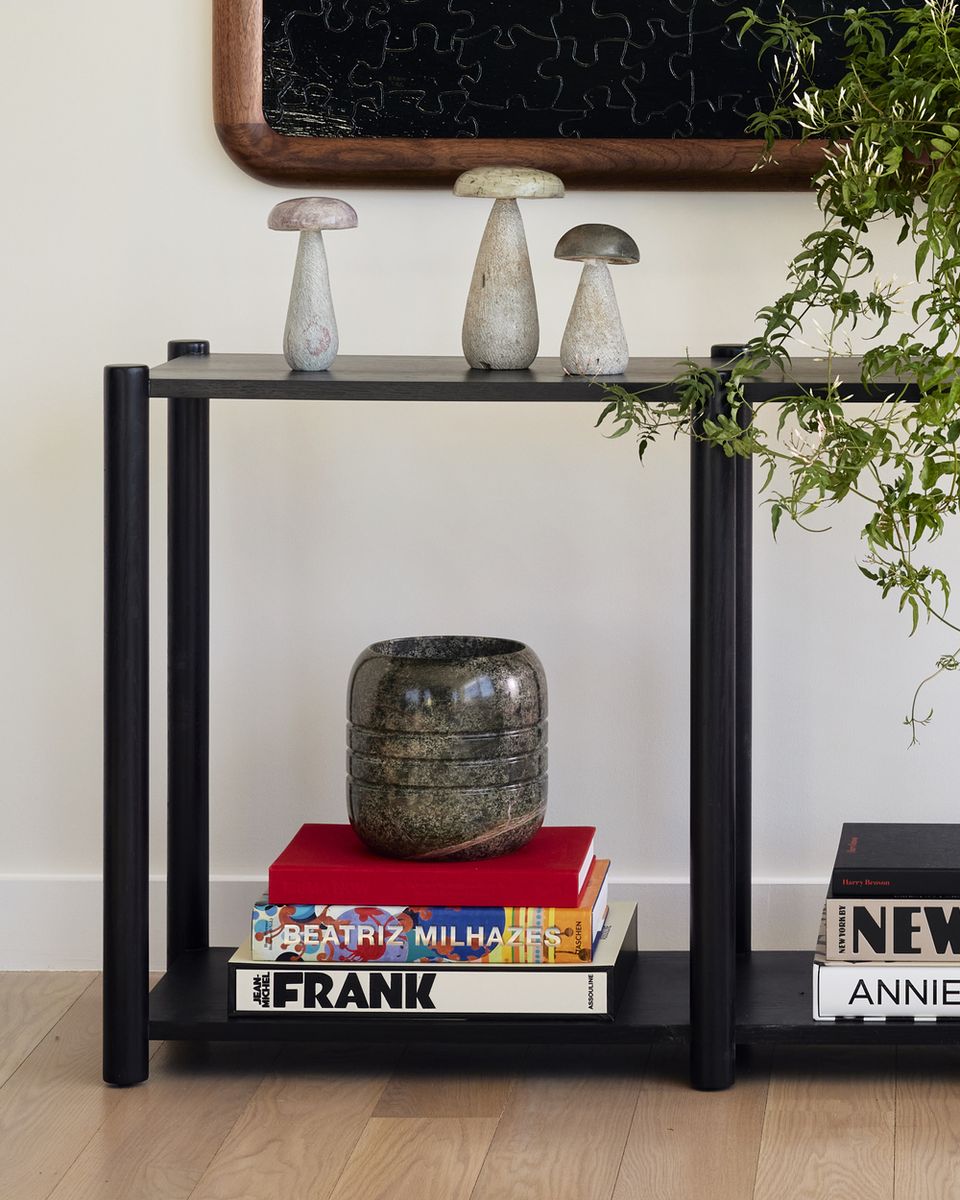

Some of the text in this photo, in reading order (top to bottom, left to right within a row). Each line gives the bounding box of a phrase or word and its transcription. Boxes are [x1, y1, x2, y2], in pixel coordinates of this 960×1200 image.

[842, 879, 863, 888] Harry
[283, 924, 405, 946] BEATRIZ
[414, 925, 562, 947] MILHAZES
[838, 905, 846, 954] NEW YORK BY
[253, 974, 262, 1005] JEAN-
[262, 971, 270, 1008] MICHEL
[273, 972, 436, 1009] FRANK
